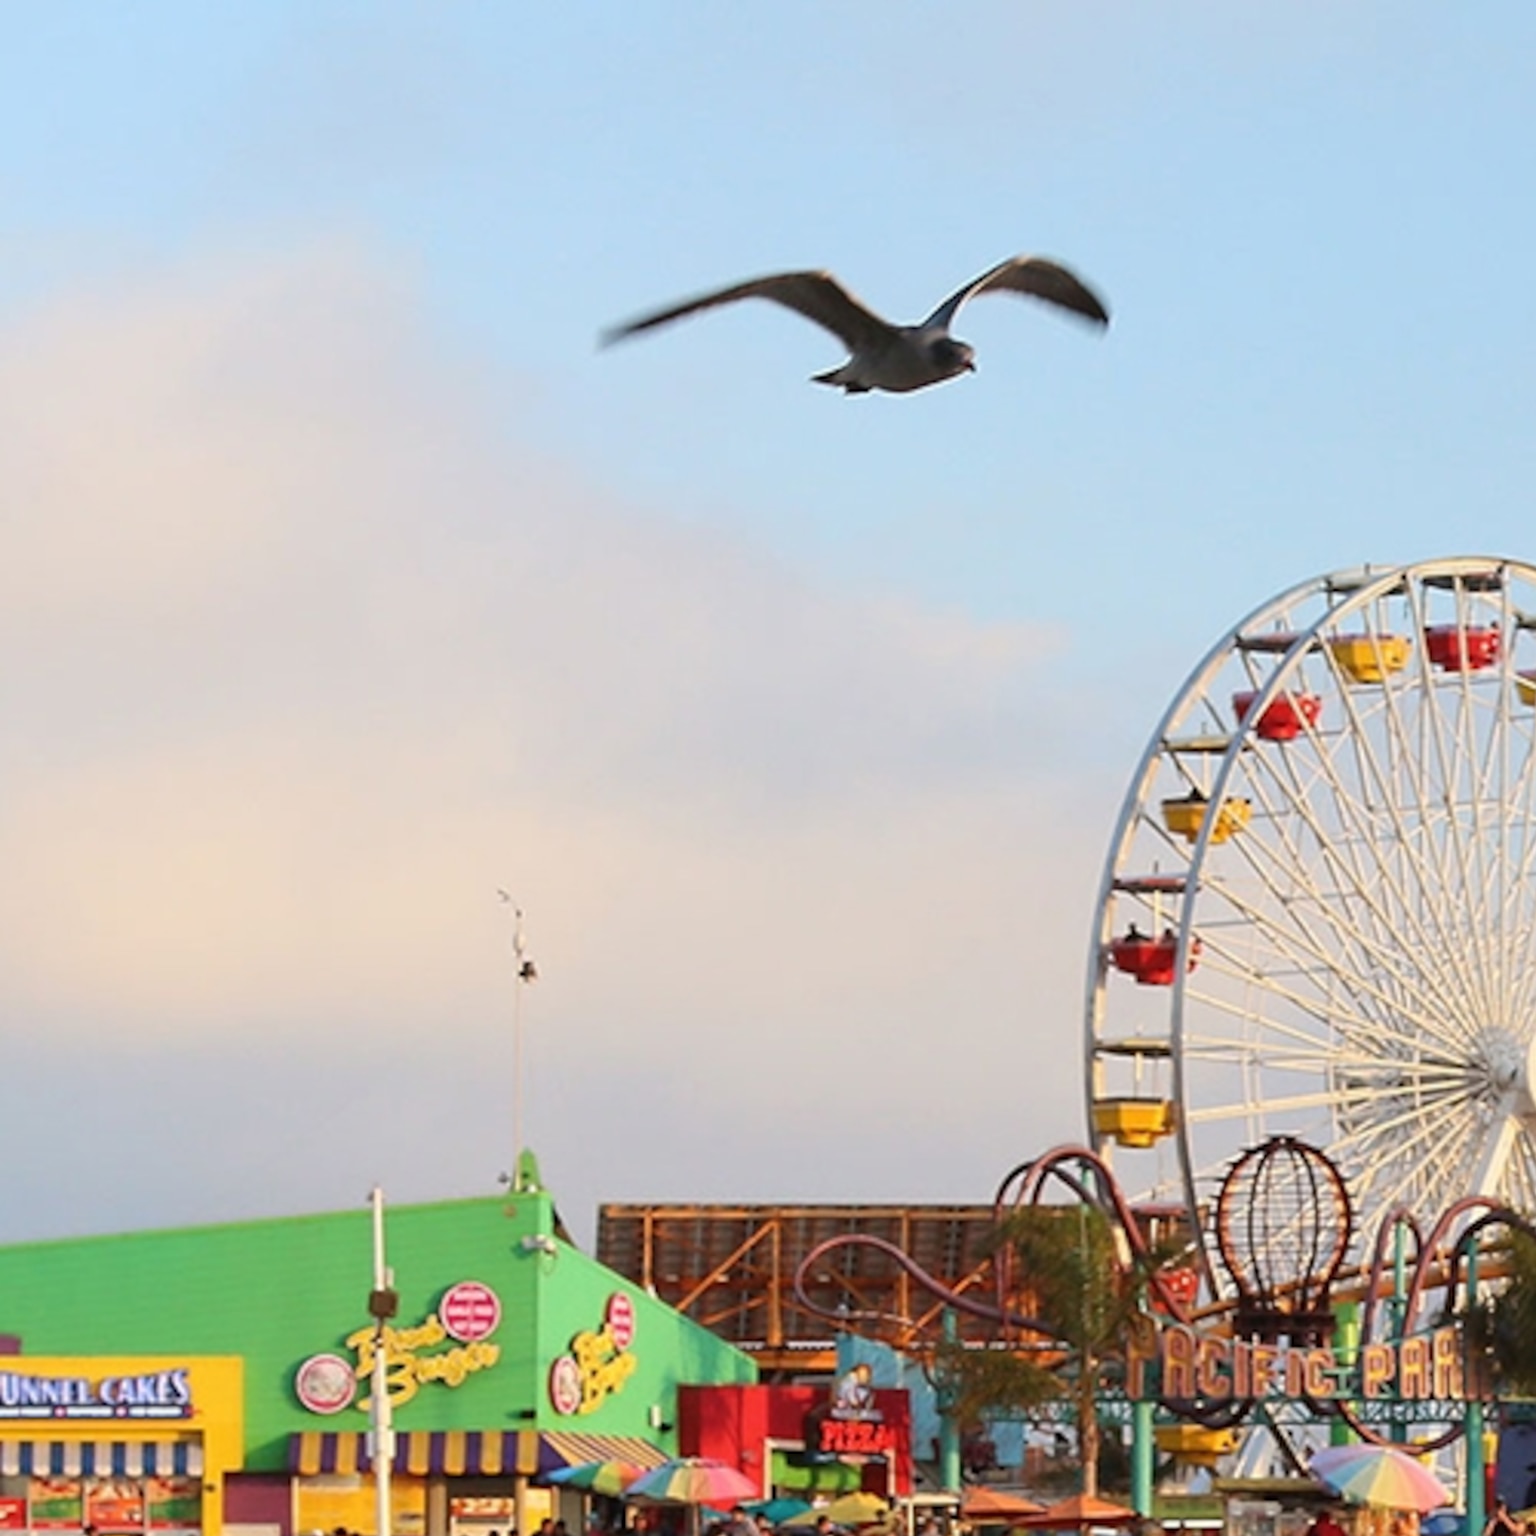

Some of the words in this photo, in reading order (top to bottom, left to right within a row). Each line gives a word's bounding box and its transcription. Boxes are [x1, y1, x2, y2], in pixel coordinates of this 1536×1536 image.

[1126, 1312, 1336, 1400] PACIFIC
[1363, 1326, 1492, 1401] PAR
[0, 1371, 94, 1407] UNNEL
[97, 1367, 190, 1406] CAKES
[820, 1419, 898, 1452] PIZZA
